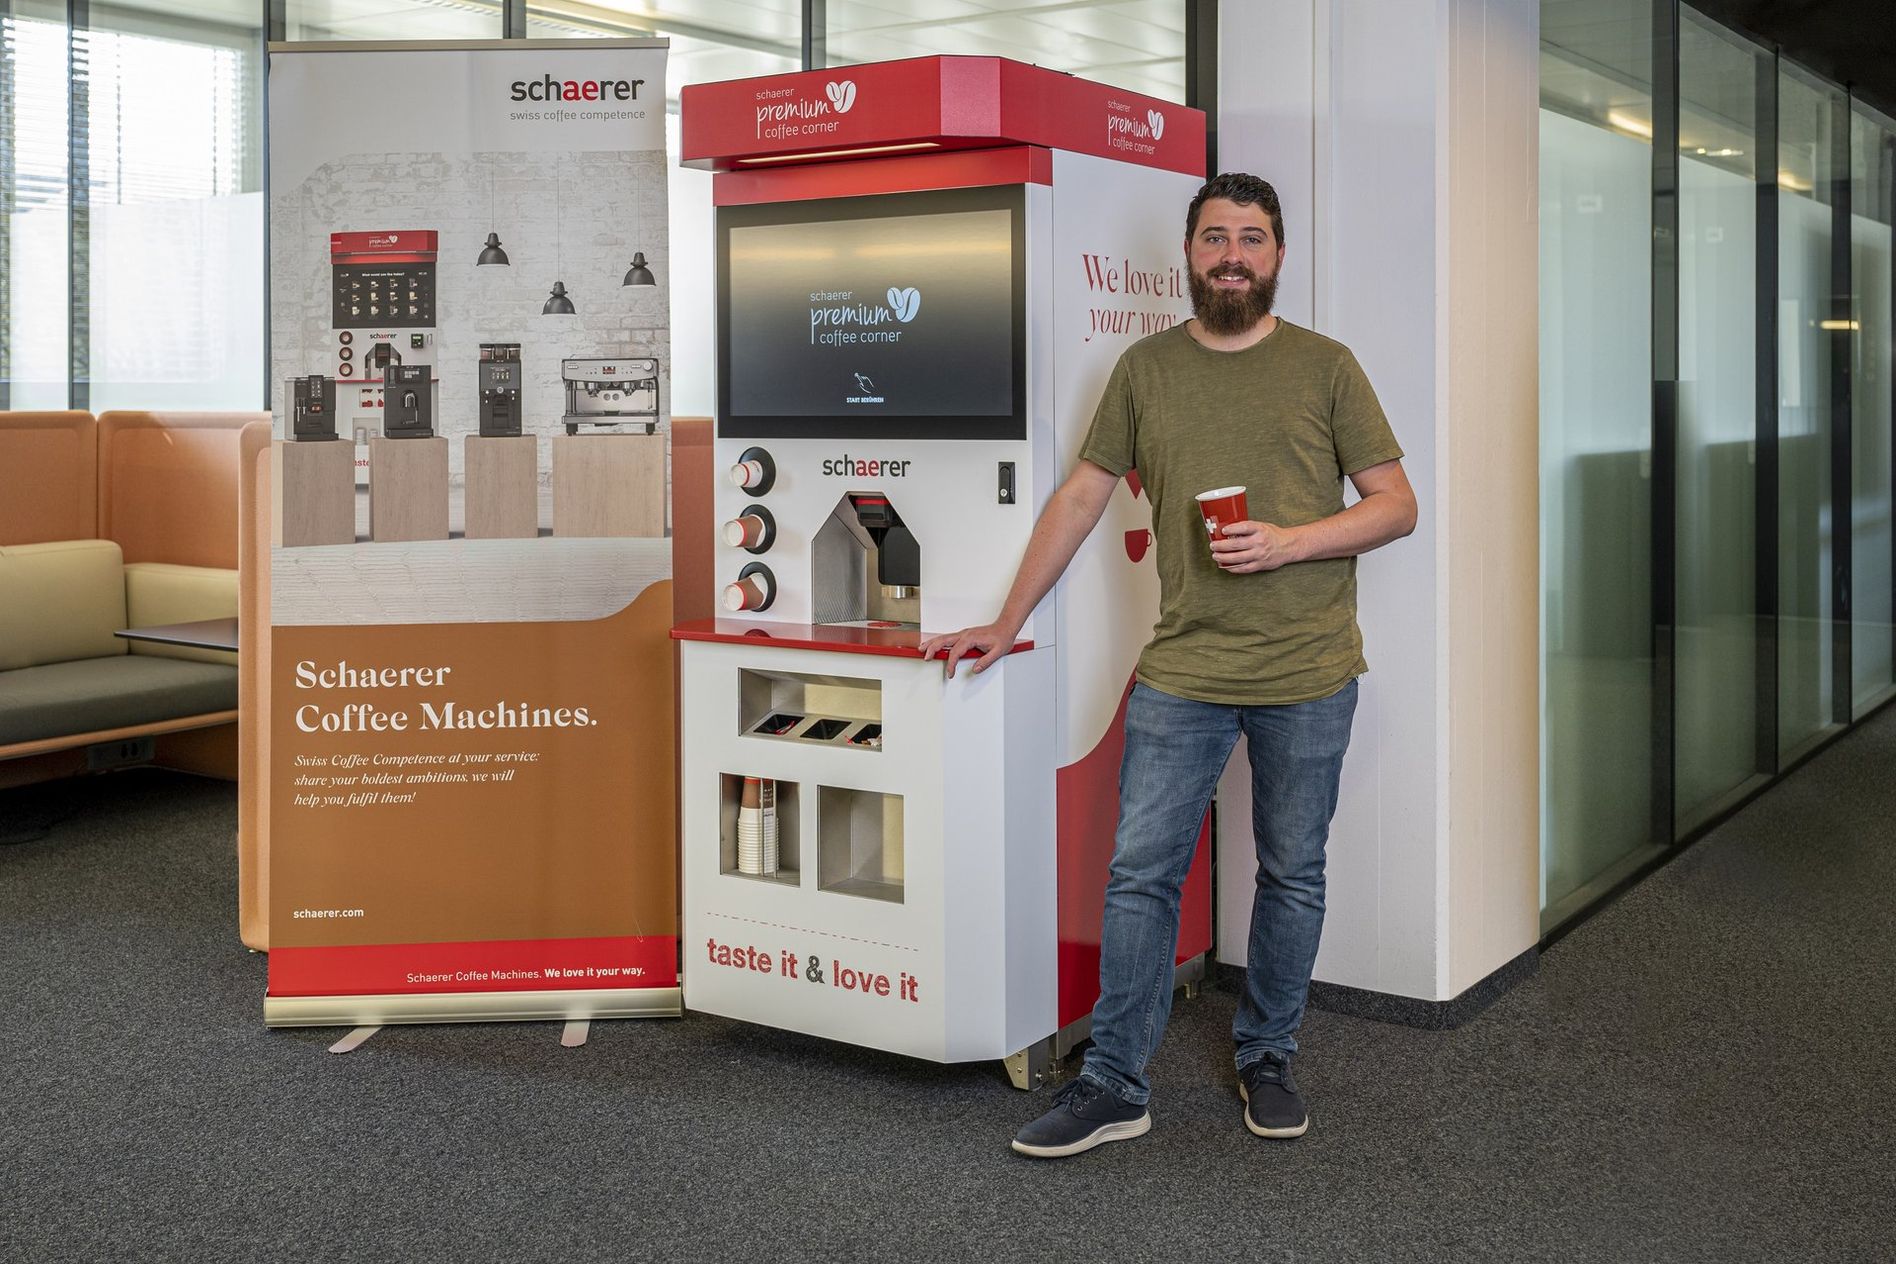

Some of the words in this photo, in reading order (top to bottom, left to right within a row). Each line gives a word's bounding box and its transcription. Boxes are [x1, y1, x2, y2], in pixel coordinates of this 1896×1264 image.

[510, 74, 645, 101] schaerer
[756, 88, 795, 100] schaerer
[1107, 100, 1131, 112] schaerer
[510, 110, 540, 121] swiss
[544, 110, 577, 122] coffee
[580, 110, 646, 121] competence
[756, 98, 831, 140] premium
[764, 123, 799, 140] coffee
[802, 121, 840, 135] corner
[1107, 114, 1151, 146] premium
[1112, 136, 1133, 151] coffee
[1134, 142, 1155, 155] corner
[1082, 254, 1118, 294] We
[1124, 258, 1164, 297] love
[1168, 266, 1182, 299] it
[810, 290, 853, 302] schaerer
[810, 303, 892, 345] premium
[1085, 308, 1136, 342] your
[820, 329, 857, 347] coffee
[860, 331, 902, 343] corner
[822, 454, 911, 477] schaerer
[295, 660, 451, 689] Schaerer
[295, 703, 408, 733] Coffee
[419, 700, 598, 731] Machines.
[294, 754, 328, 767] Swiss
[331, 753, 369, 769] Coffee
[373, 751, 446, 767] Competence
[448, 753, 461, 764] at
[462, 753, 492, 766] your
[294, 774, 327, 787] share
[328, 776, 358, 788] your
[361, 772, 403, 785] boldest
[472, 773, 488, 782] we
[491, 769, 515, 782] will
[293, 793, 320, 808] help
[320, 795, 344, 808] you
[343, 792, 379, 808] fulfil
[380, 791, 417, 804] them!
[293, 908, 365, 919] schaerer.com
[406, 972, 454, 983] Schaerer
[455, 970, 489, 981] Coffee
[491, 968, 542, 980] Machines.
[544, 968, 561, 978] We
[563, 967, 585, 977] love
[586, 966, 595, 977] it
[596, 967, 620, 979] your
[621, 967, 646, 977] way.
[707, 937, 772, 974] taste
[781, 949, 798, 979] it
[806, 954, 825, 985] &
[833, 959, 891, 997] love
[900, 971, 919, 1003] it
